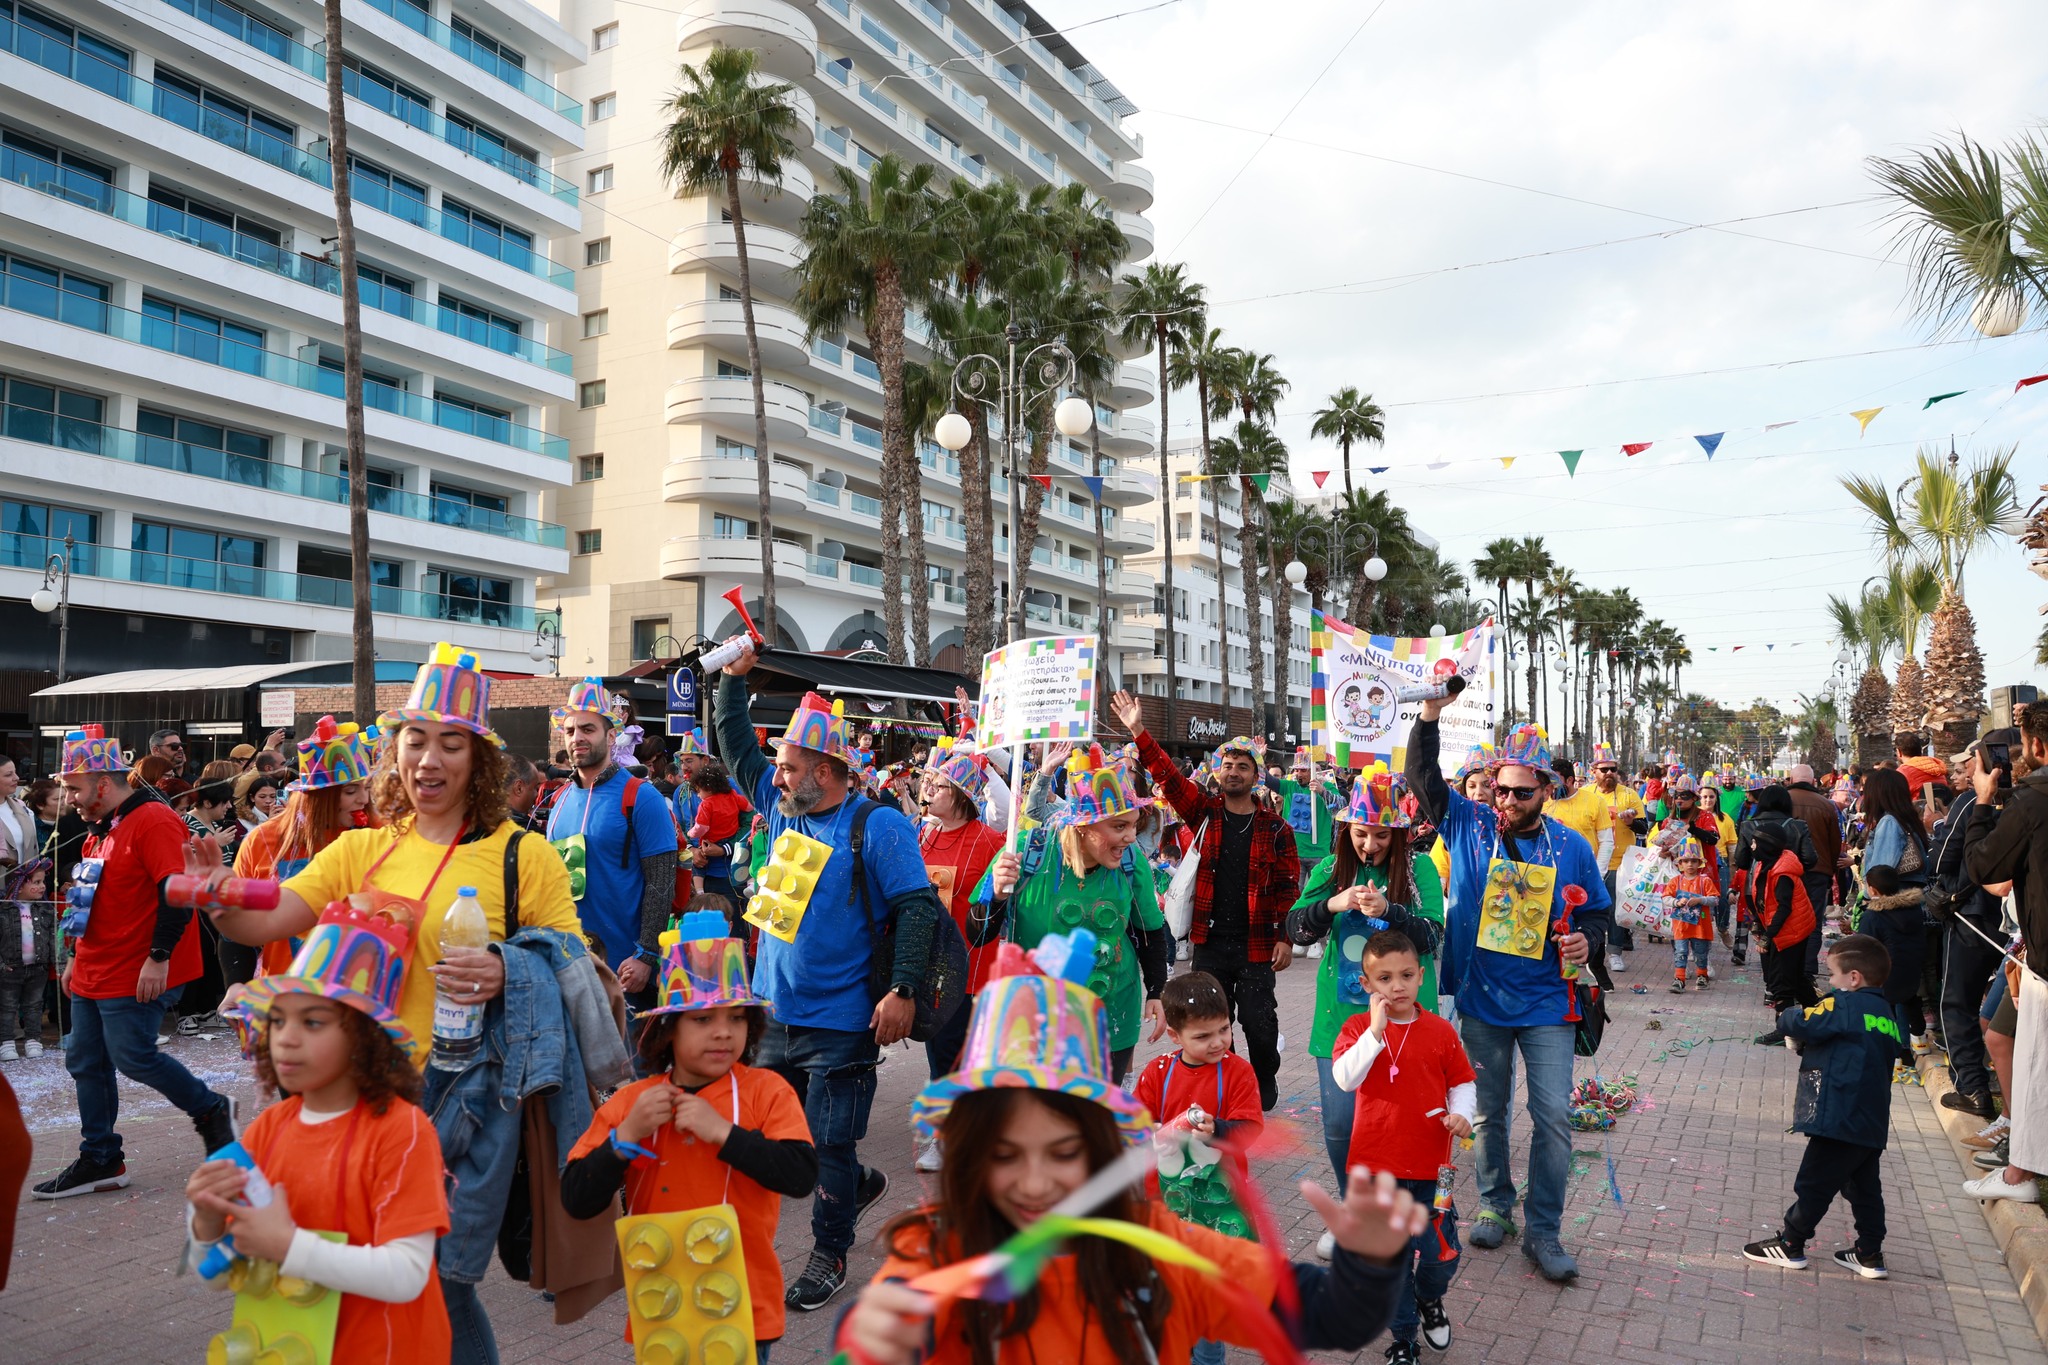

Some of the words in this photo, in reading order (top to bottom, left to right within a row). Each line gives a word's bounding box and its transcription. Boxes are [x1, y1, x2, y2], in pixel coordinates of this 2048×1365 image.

[1352, 671, 1380, 682] Μικρά
[680, 682, 691, 694] HB
[438, 1007, 465, 1018] πηγή
